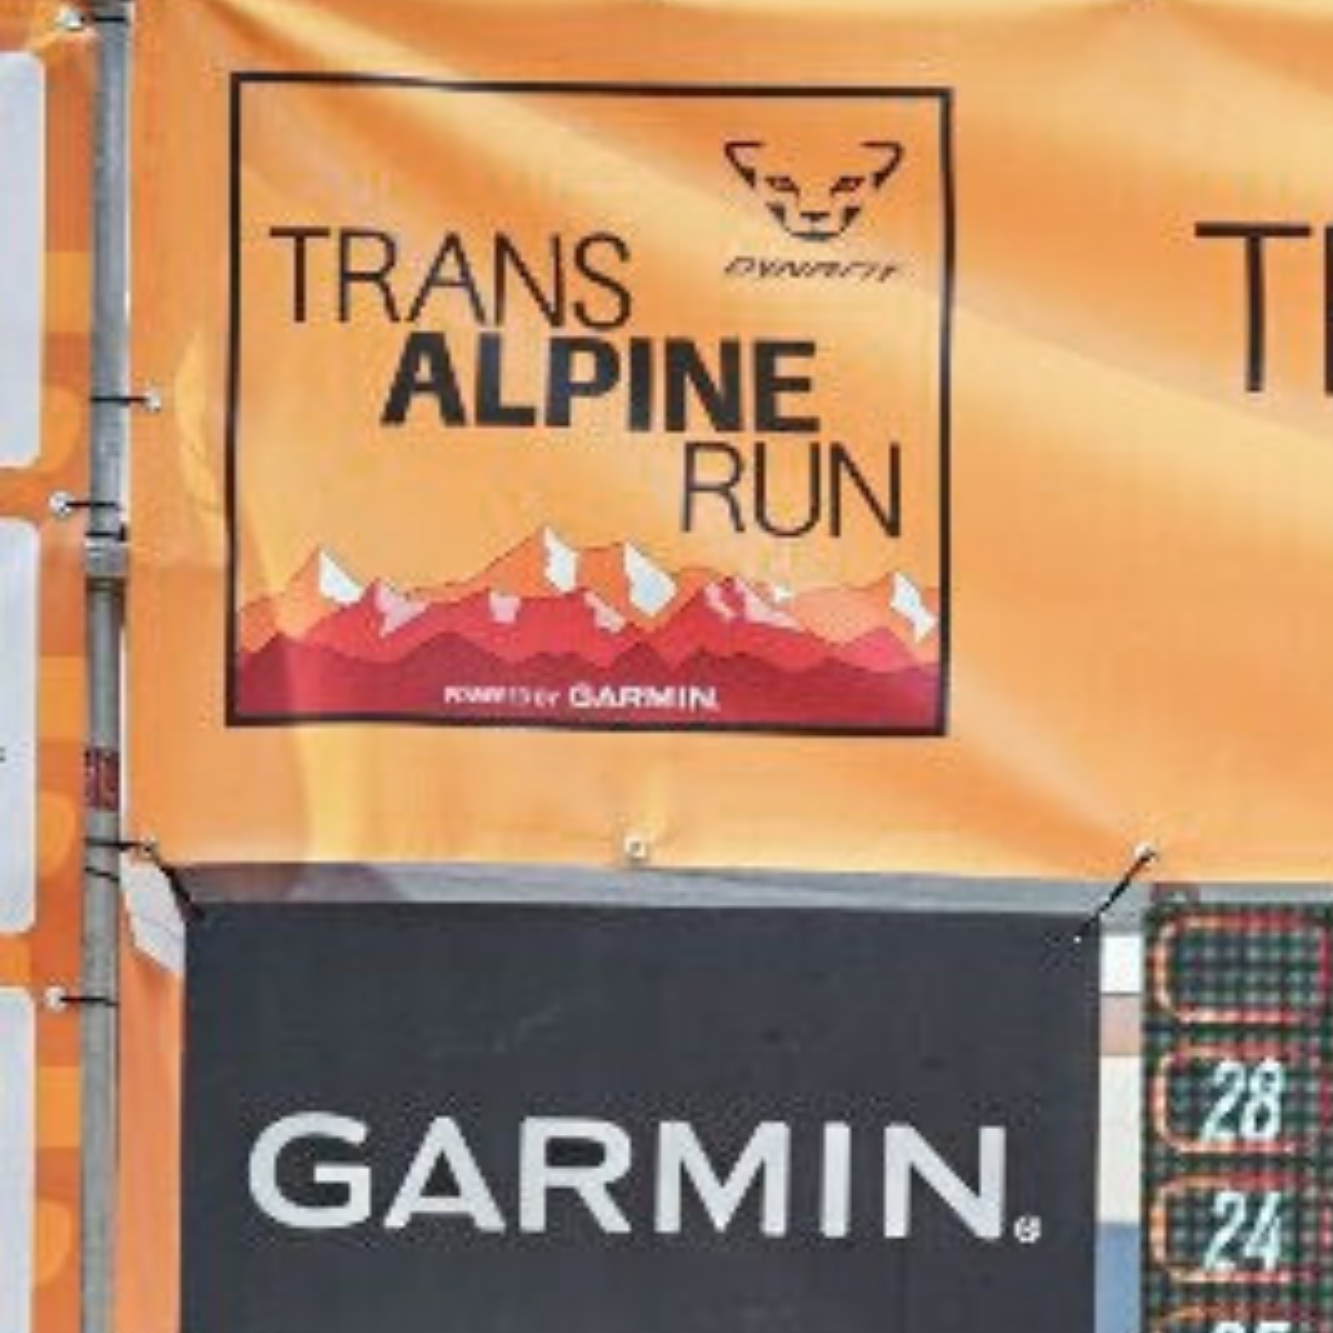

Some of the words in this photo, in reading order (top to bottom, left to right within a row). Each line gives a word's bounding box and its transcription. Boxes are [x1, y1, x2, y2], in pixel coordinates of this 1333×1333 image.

[269, 226, 634, 331] TRANS
[381, 331, 820, 433] ALPINE
[680, 441, 902, 539] RUN
[568, 682, 718, 711] GARMIN
[1202, 1059, 1282, 1144] 28
[248, 1110, 1007, 1241] GARMIN
[1204, 1189, 1283, 1273] 24
